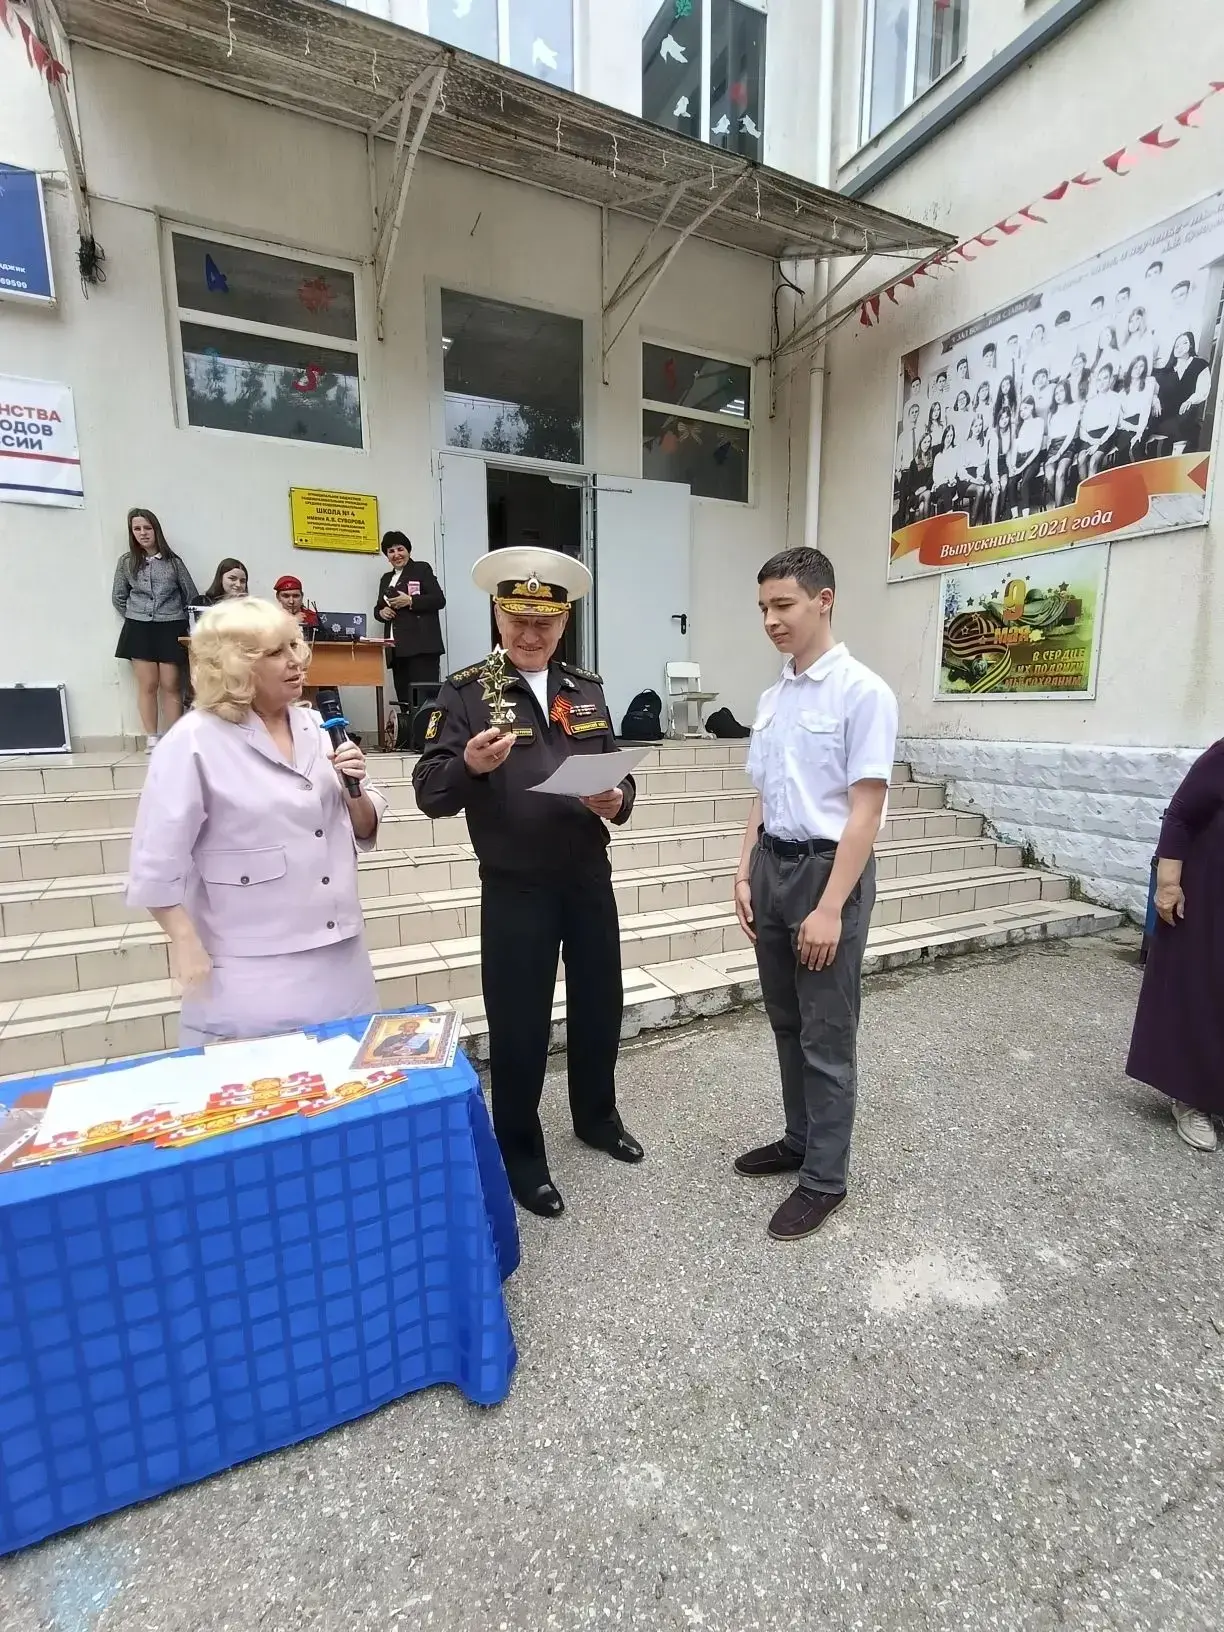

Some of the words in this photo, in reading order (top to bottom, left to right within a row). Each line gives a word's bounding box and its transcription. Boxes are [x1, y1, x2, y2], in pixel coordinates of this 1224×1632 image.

[0, 420, 53, 437] ОДОВ
[0, 435, 43, 451] СИИ
[940, 530, 1026, 559] Выпускники
[1027, 517, 1068, 541] 2021
[1071, 509, 1113, 530] года
[1002, 578, 1027, 621] 9
[1032, 651, 1040, 662] В
[1043, 648, 1086, 662] СЕРДЦЕ
[1017, 664, 1032, 674] ИХ
[1026, 675, 1082, 687] СОХРАНИМ
